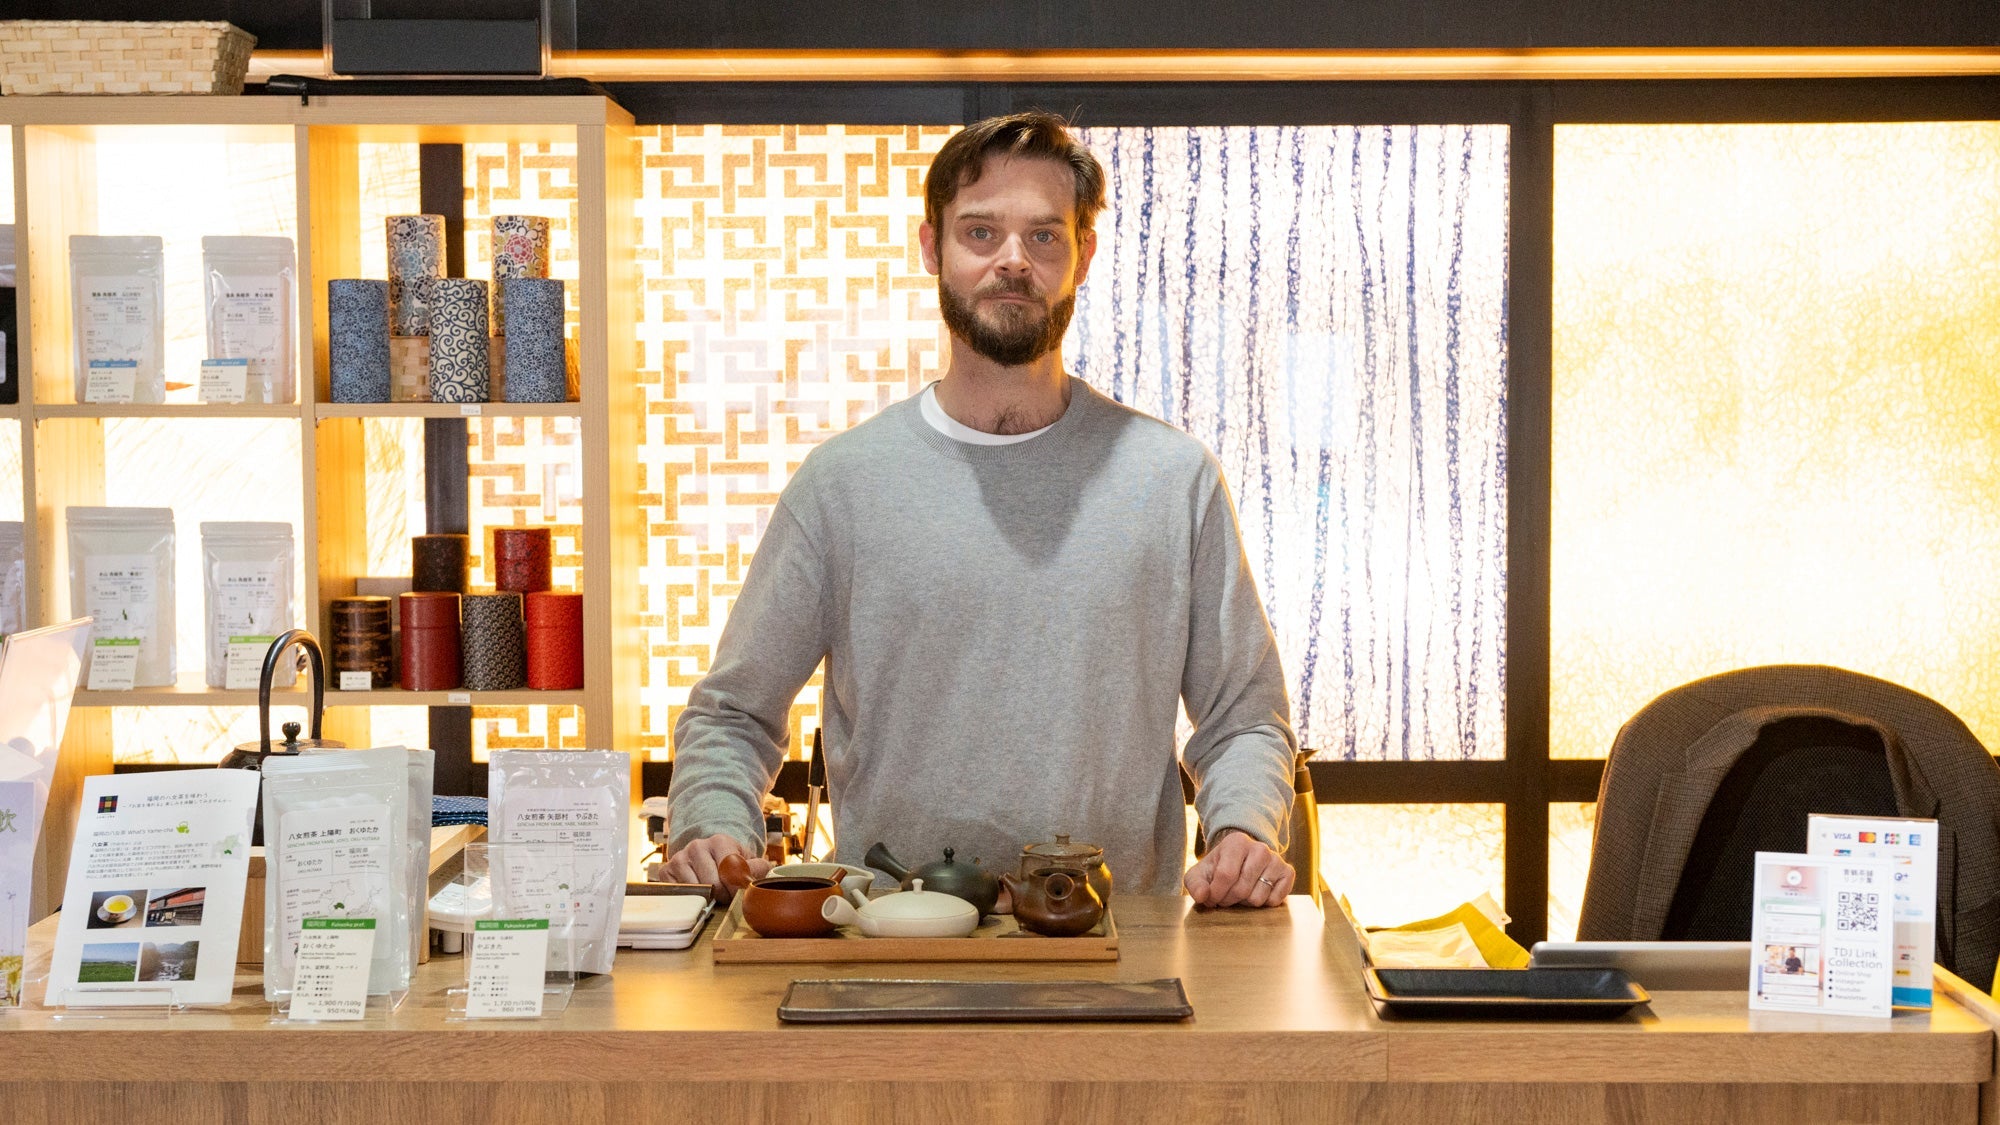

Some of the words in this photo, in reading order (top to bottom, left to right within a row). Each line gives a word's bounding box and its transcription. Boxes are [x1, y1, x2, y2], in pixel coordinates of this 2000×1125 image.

[288, 831, 318, 841] 八女煎茶
[320, 828, 342, 837] 上陽町
[349, 826, 379, 835] おくゆたか
[297, 859, 323, 867] おくゆたか
[1833, 947, 1853, 957] TDJ
[1856, 949, 1878, 959] Link
[1828, 957, 1883, 969] Collection
